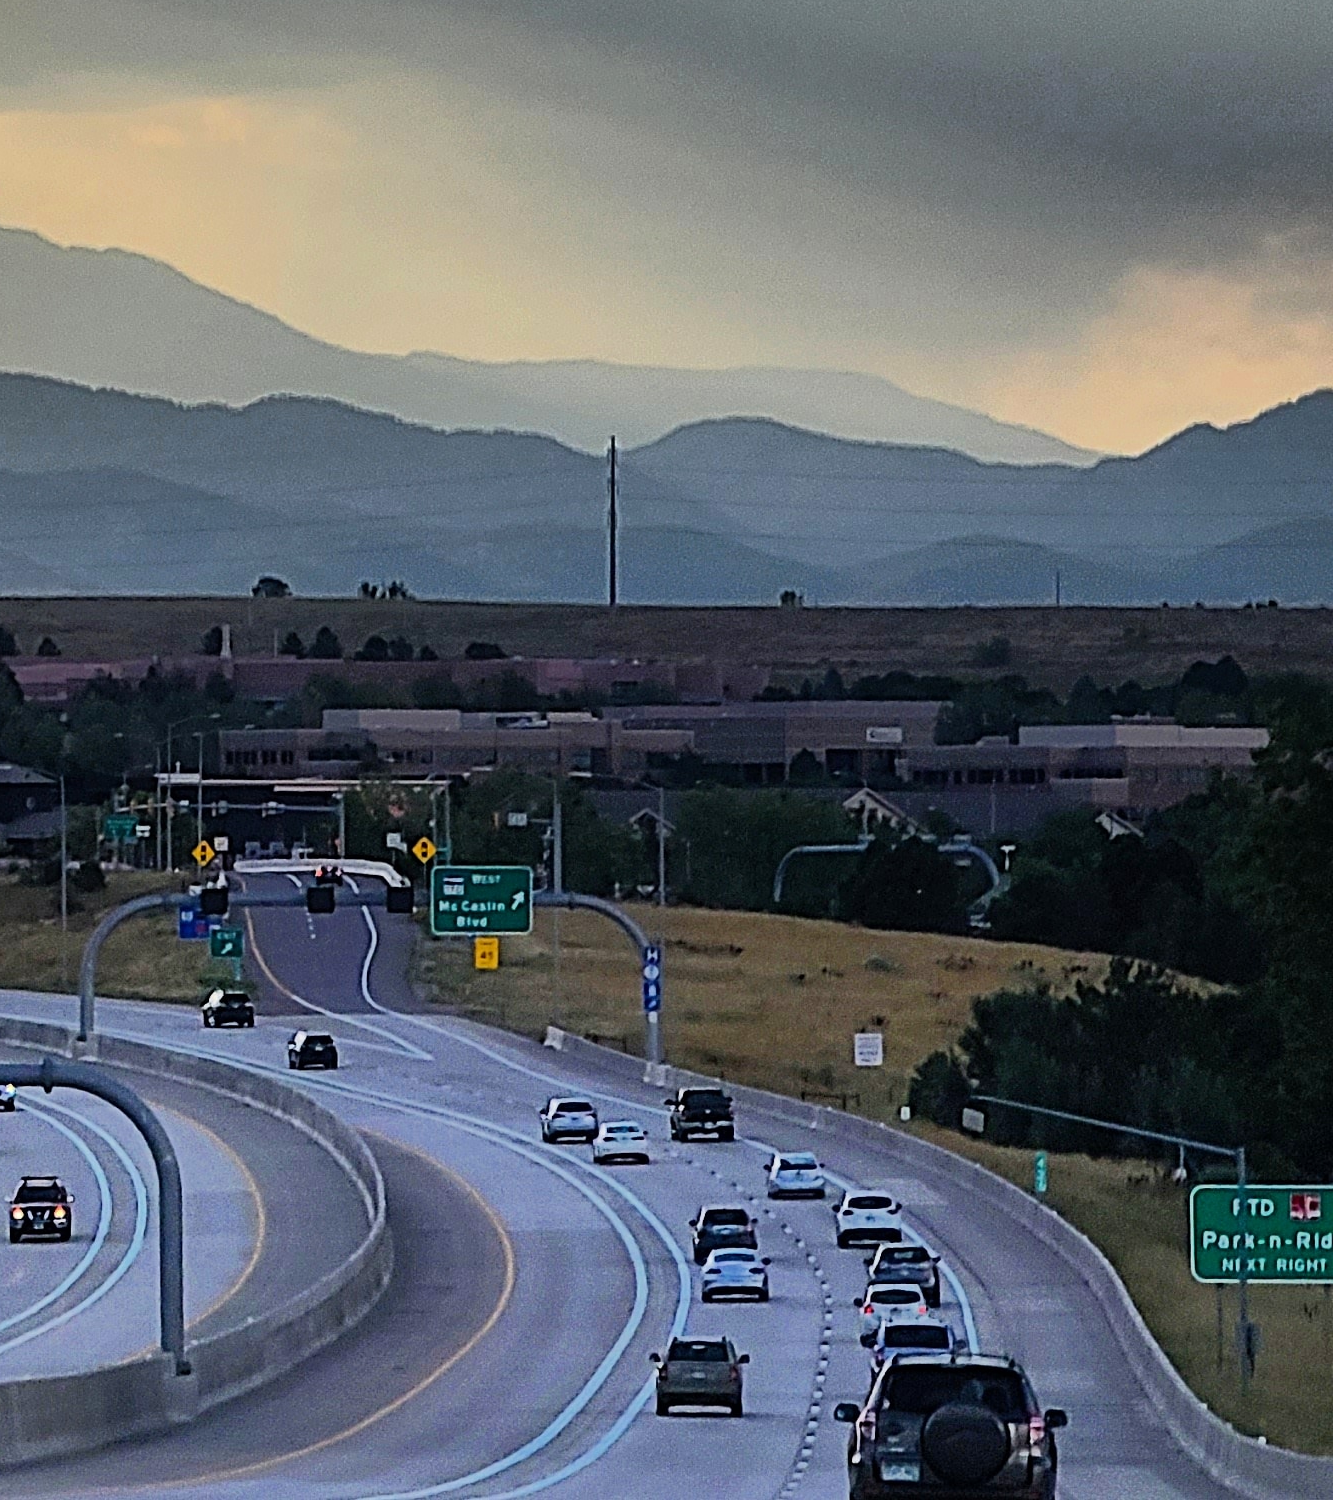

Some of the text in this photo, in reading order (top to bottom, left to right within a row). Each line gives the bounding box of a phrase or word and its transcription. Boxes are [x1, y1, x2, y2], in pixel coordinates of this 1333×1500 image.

[456, 915, 488, 928] Blvd
[1202, 1230, 1333, 1250] Park-n-Rid
[1276, 1257, 1328, 1273] RIGHT
